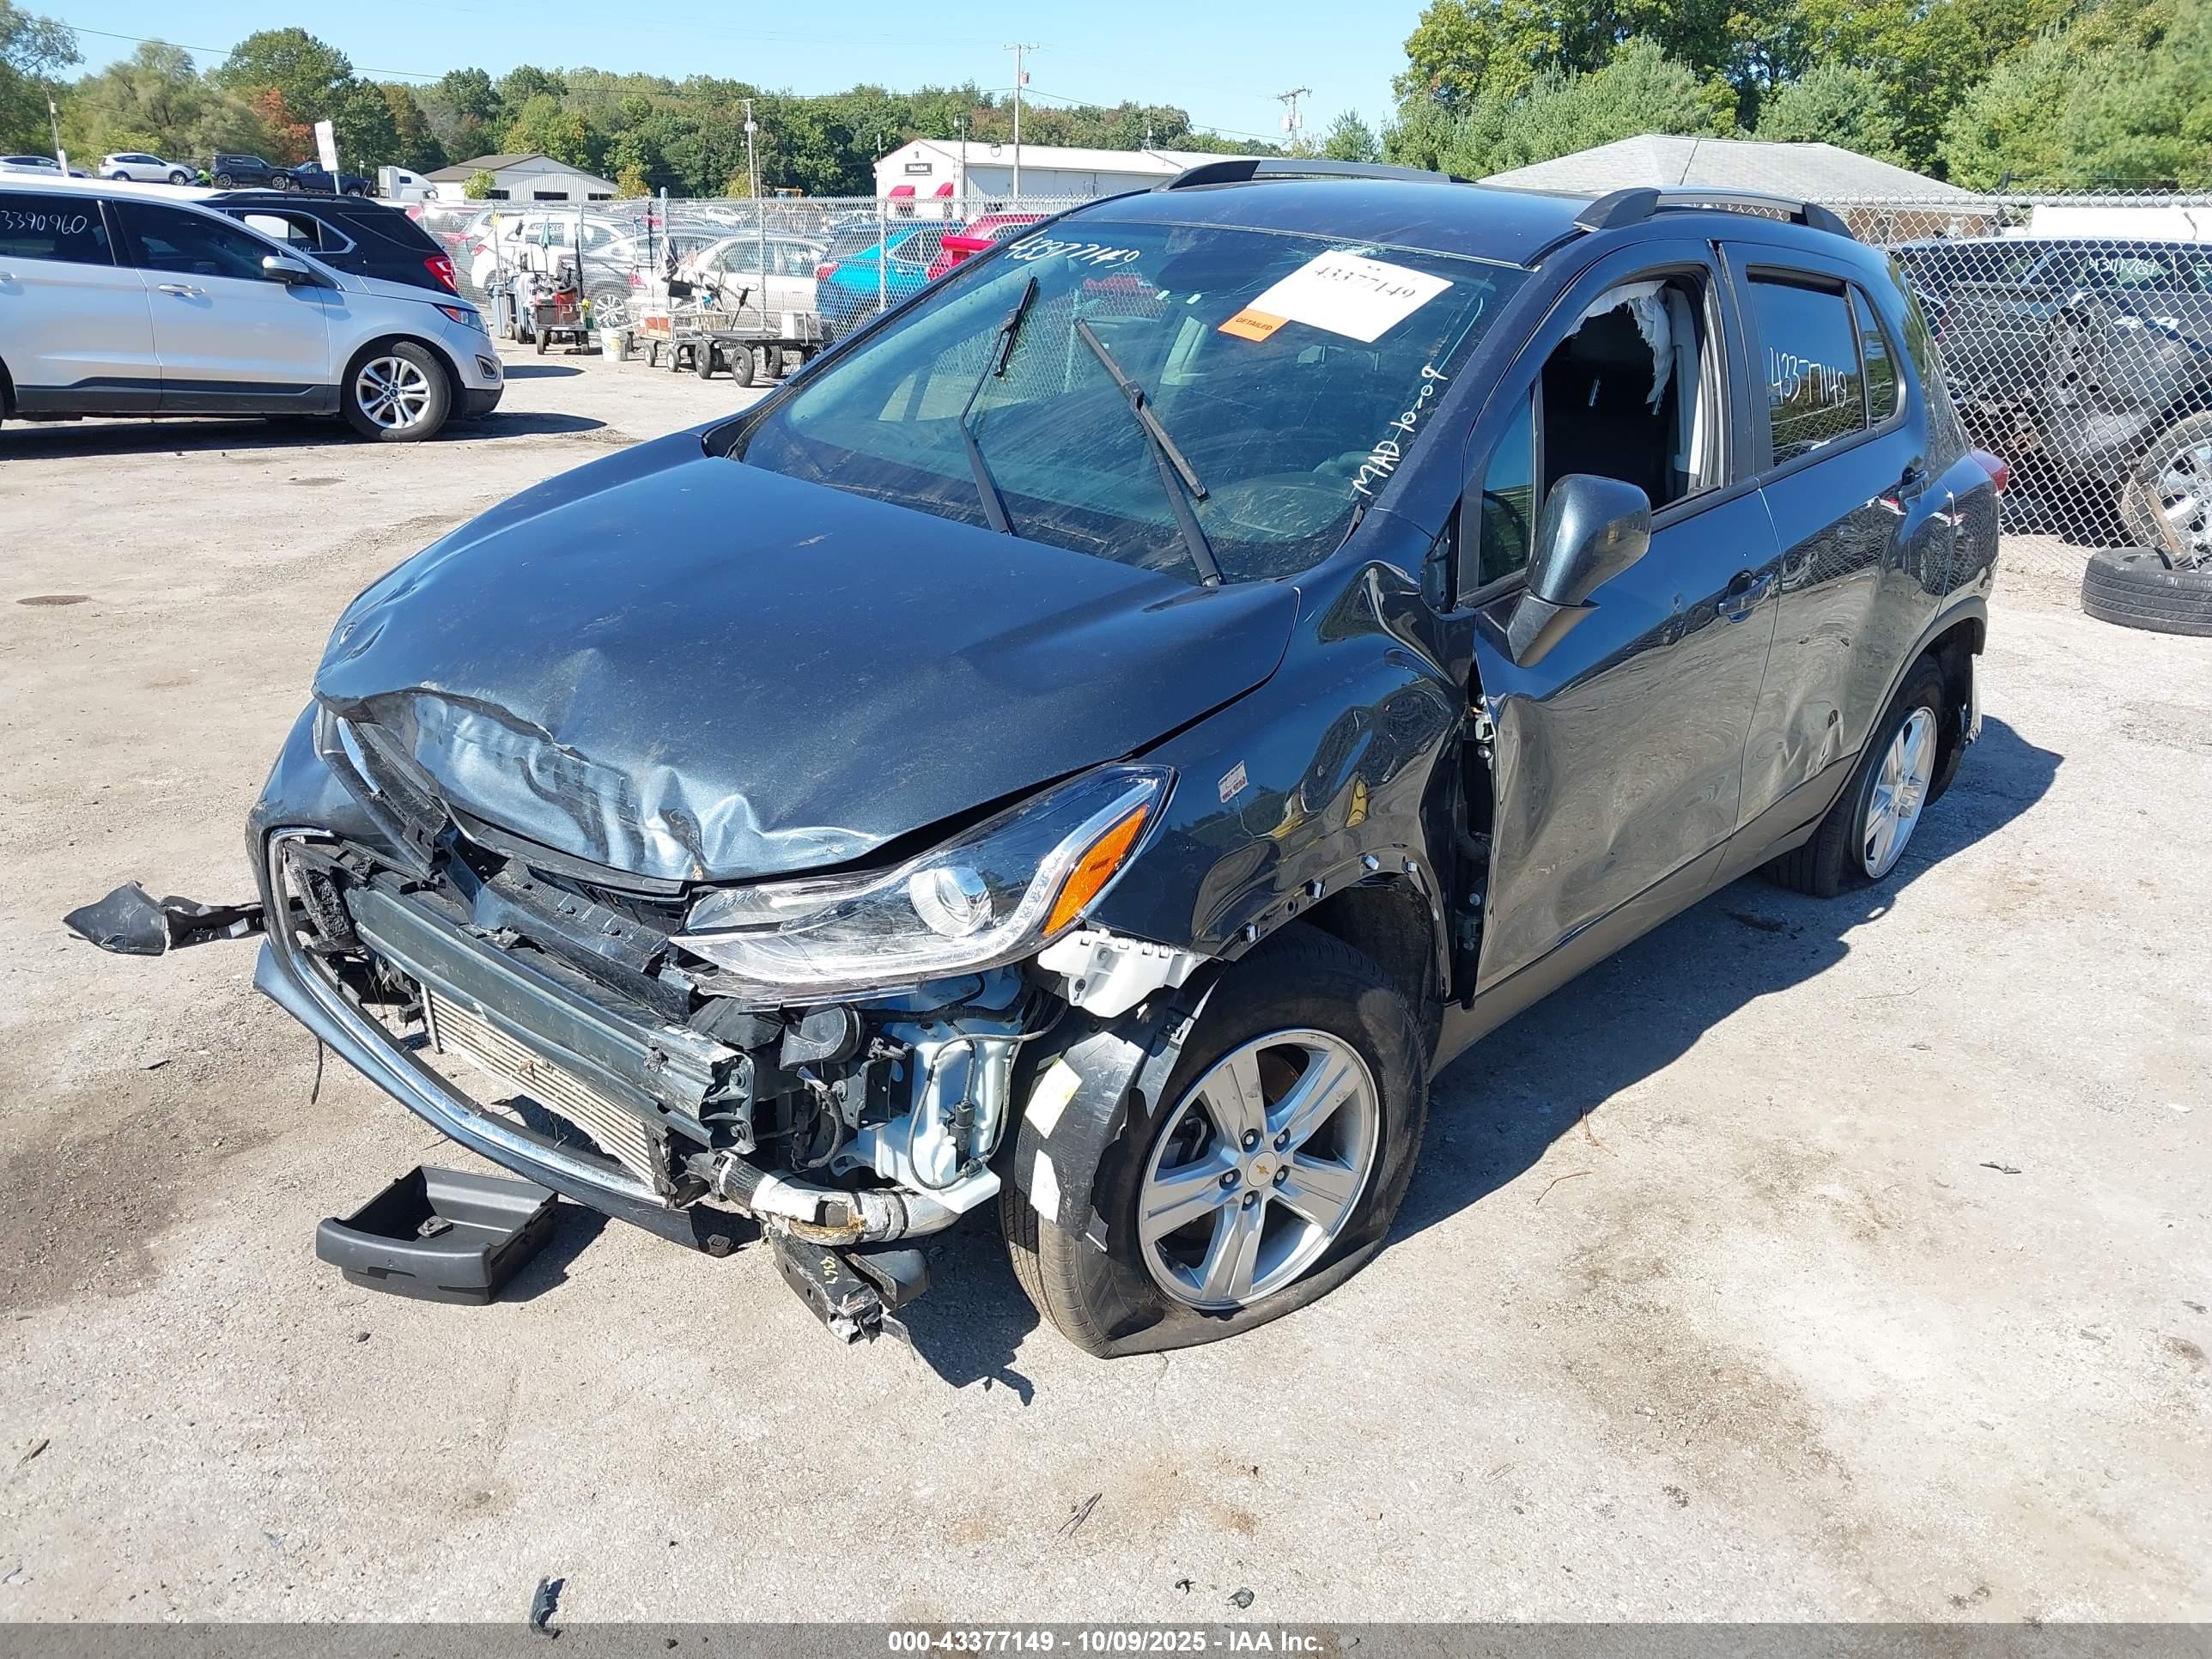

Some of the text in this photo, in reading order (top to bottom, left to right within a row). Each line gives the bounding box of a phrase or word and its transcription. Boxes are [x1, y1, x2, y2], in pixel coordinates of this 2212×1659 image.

[1004, 228, 1140, 269] 43377149
[1235, 316, 1274, 332] DETAILED
[1769, 346, 1848, 409] 43377149
[1352, 365, 1449, 496] MAD 10-09
